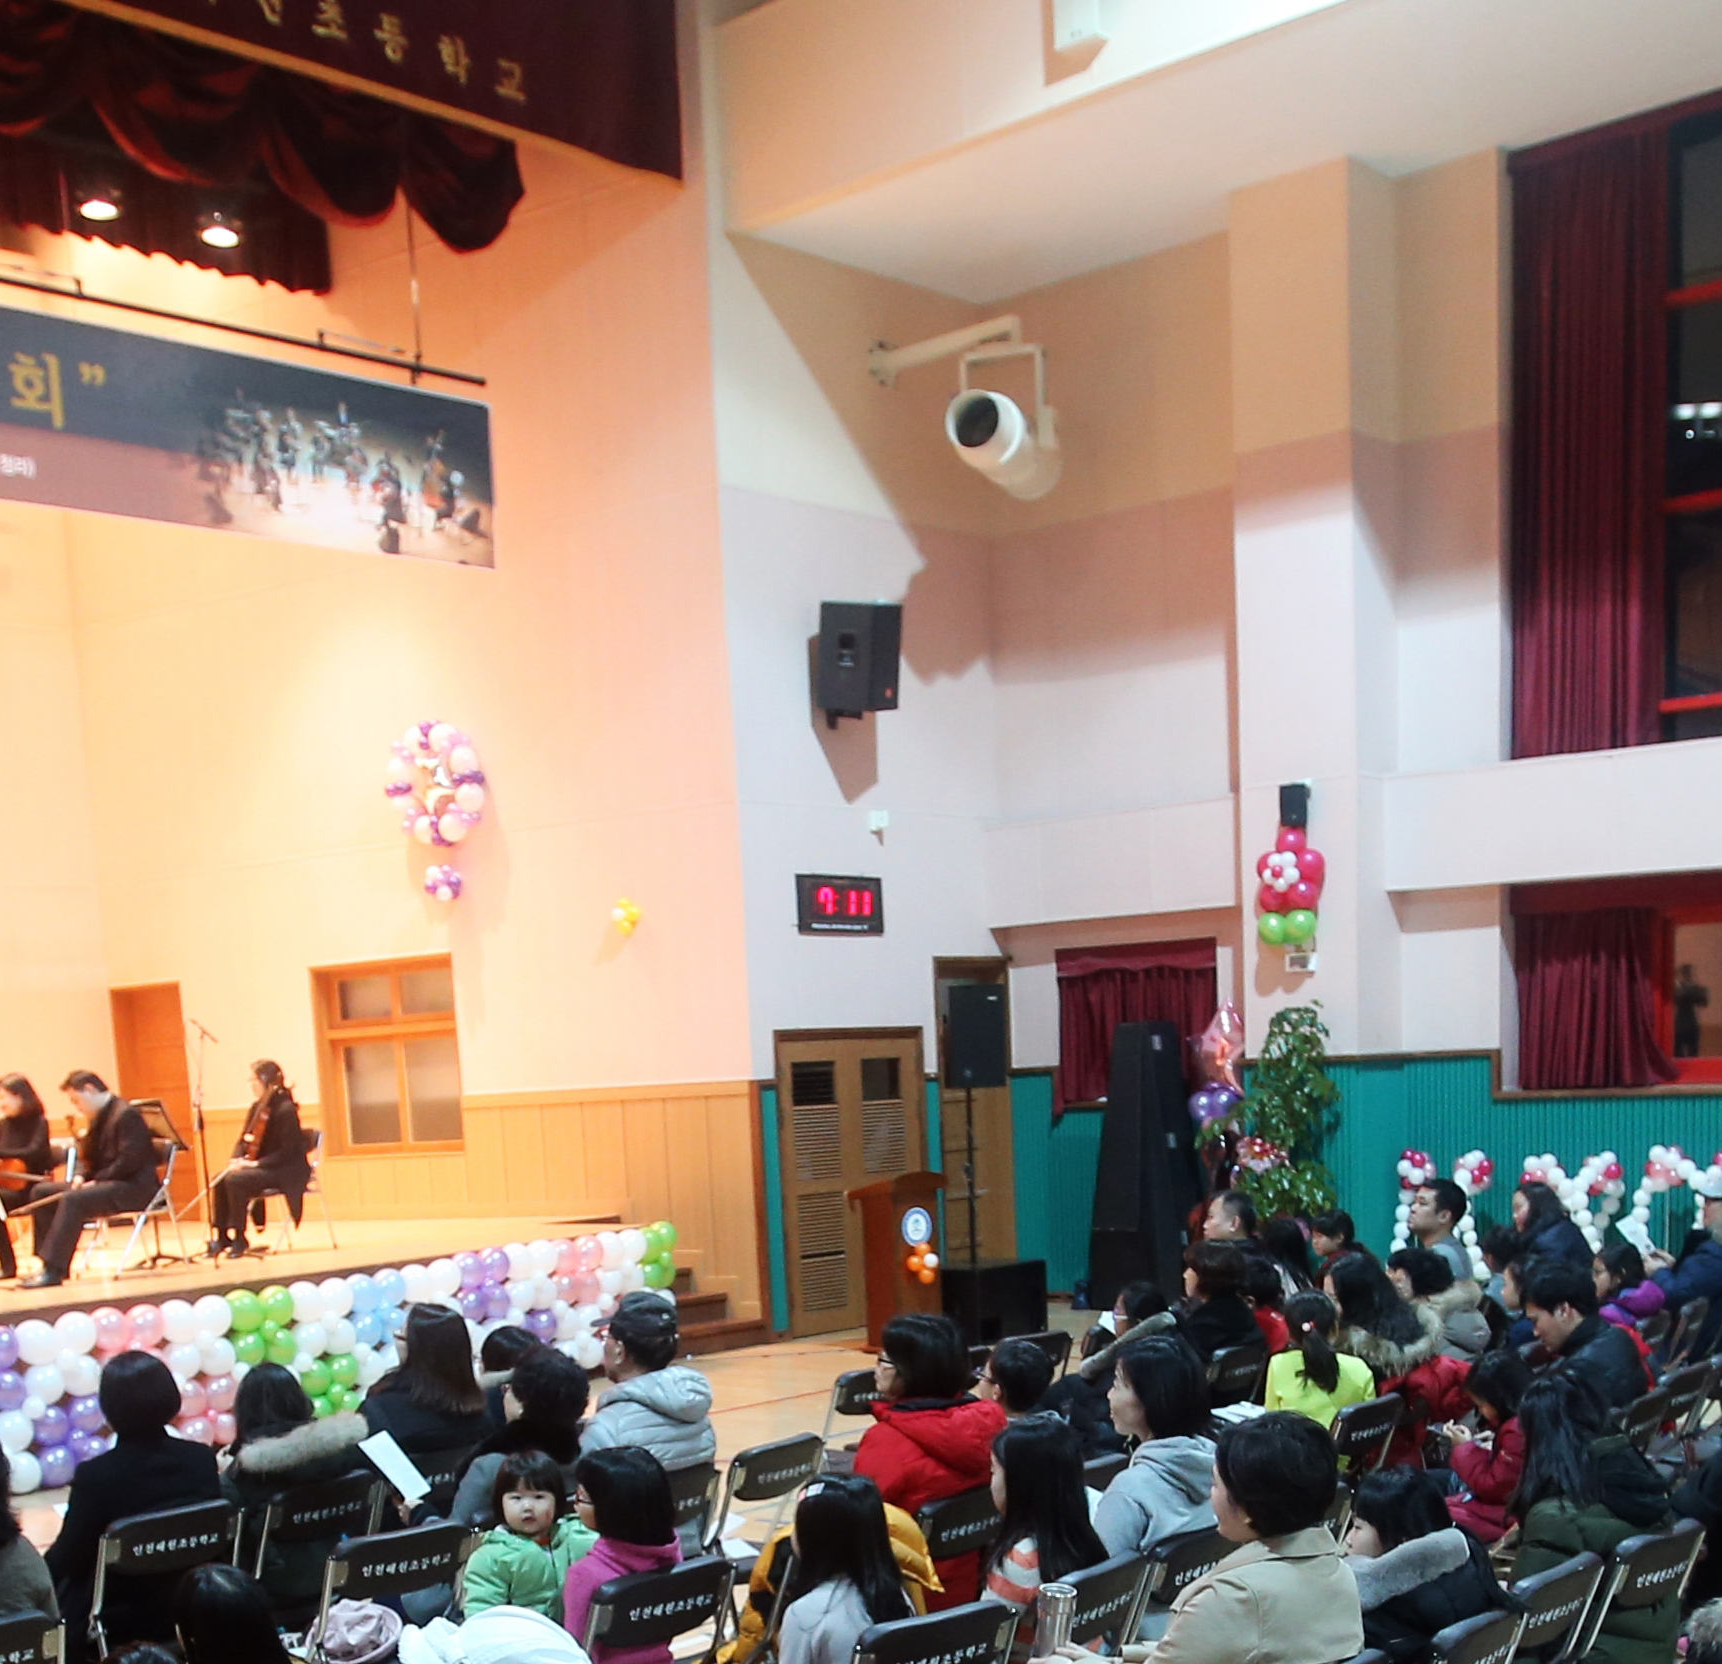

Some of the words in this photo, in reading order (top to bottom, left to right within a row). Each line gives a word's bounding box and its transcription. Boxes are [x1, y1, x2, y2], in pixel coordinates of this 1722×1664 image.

[260, 0, 525, 104] 초등학교
[133, 1533, 218, 1556] 인천해원초등학교
[361, 1553, 452, 1577] 인천해원초등학교
[630, 1594, 713, 1621] 인천해원초등학교
